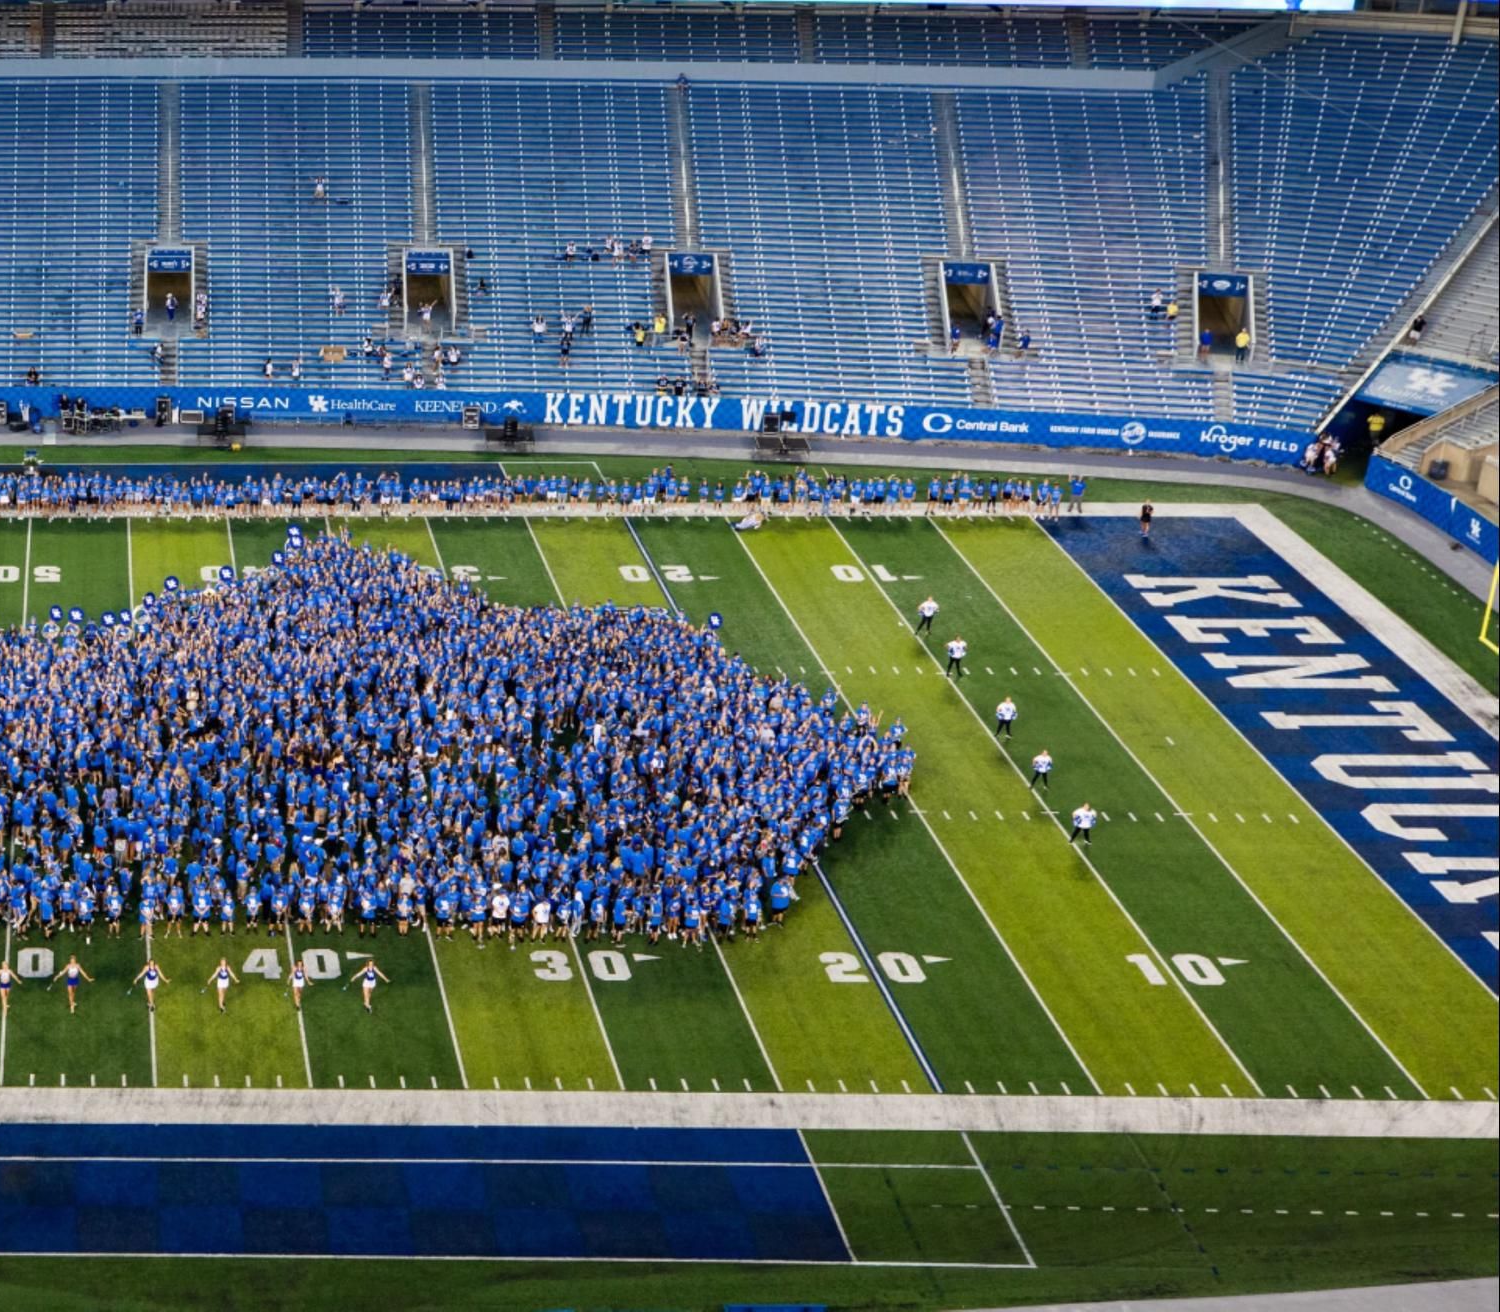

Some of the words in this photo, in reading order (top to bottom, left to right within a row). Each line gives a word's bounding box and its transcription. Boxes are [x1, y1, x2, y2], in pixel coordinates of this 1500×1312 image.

[197, 397, 289, 409] NISSAN
[330, 398, 397, 413] HealthCare
[543, 392, 720, 429] KENTUCKY
[956, 418, 998, 432] Central
[999, 420, 1029, 433] Bank
[1200, 424, 1254, 453] Kroger
[1258, 438, 1299, 453] FIELD
[618, 565, 696, 583] 20
[829, 565, 899, 583] 10
[242, 948, 341, 980] 40
[529, 950, 632, 981] 30
[817, 951, 928, 983] 20
[1125, 953, 1228, 986] 10
